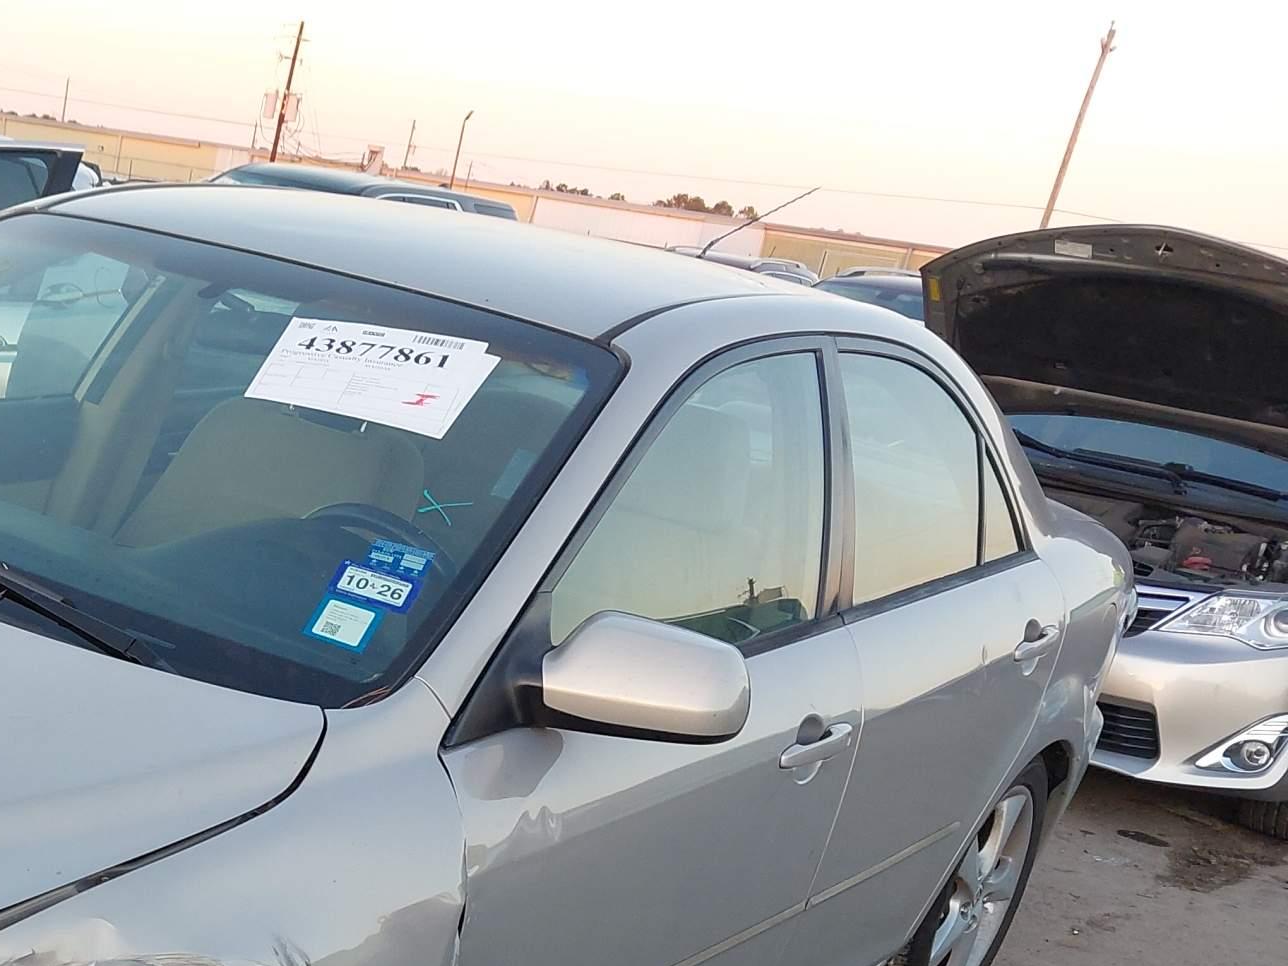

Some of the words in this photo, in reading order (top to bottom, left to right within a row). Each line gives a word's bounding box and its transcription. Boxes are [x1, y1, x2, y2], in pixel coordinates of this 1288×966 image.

[297, 335, 450, 369] 43877861
[346, 574, 369, 590] 10
[377, 584, 404, 601] 26
